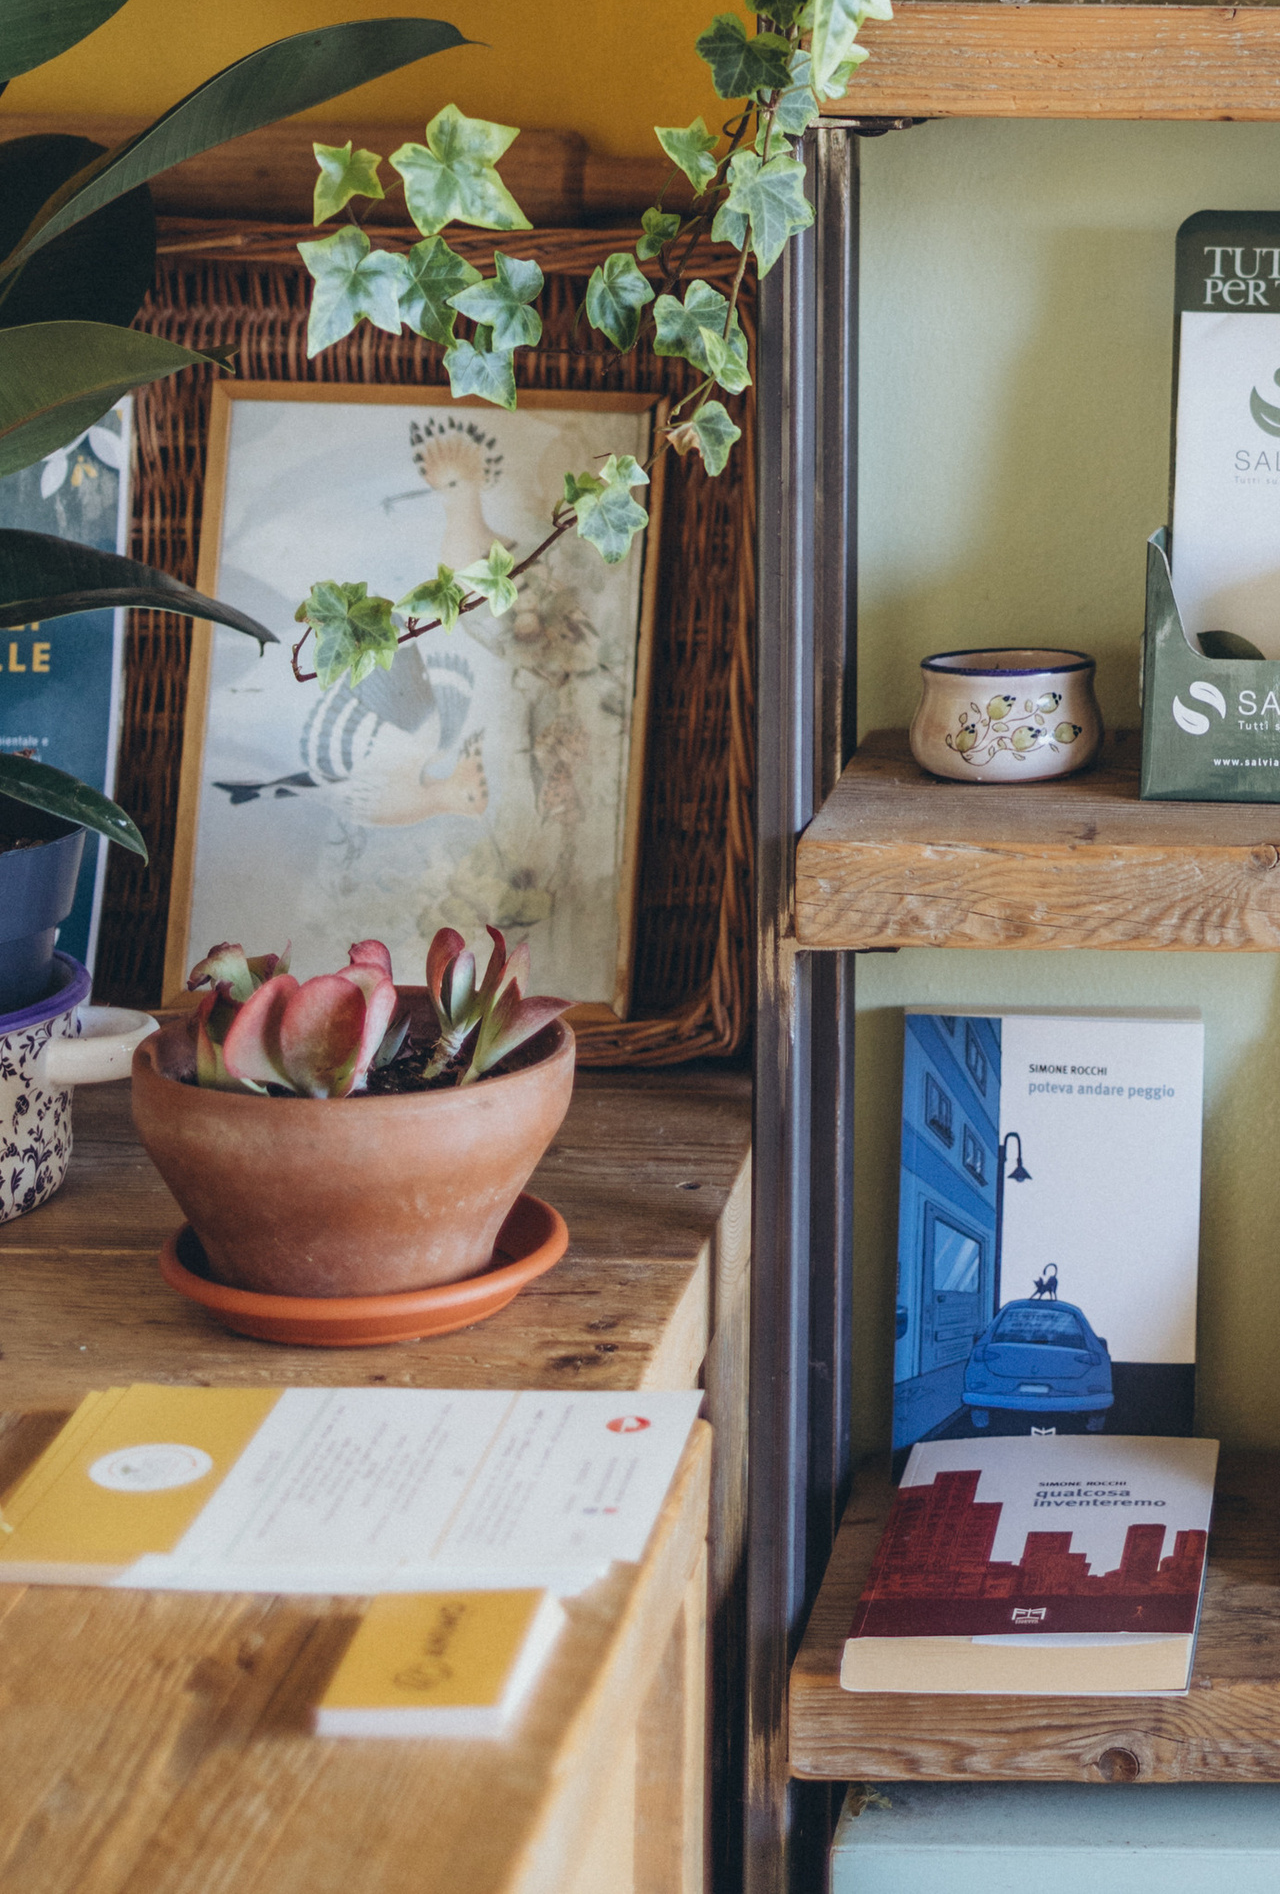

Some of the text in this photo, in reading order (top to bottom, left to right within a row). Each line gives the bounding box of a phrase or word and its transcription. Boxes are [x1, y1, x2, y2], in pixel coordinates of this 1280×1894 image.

[1234, 476, 1260, 485] Tutti
[1266, 477, 1278, 485] su
[1238, 720, 1269, 731] Tutti
[1028, 1063, 1107, 1076] SIMONE ROCCHI
[1028, 1081, 1175, 1100] poteva andare peggio
[1036, 1488, 1131, 1499] qualcosa
[1033, 1498, 1166, 1507] inventeremo
